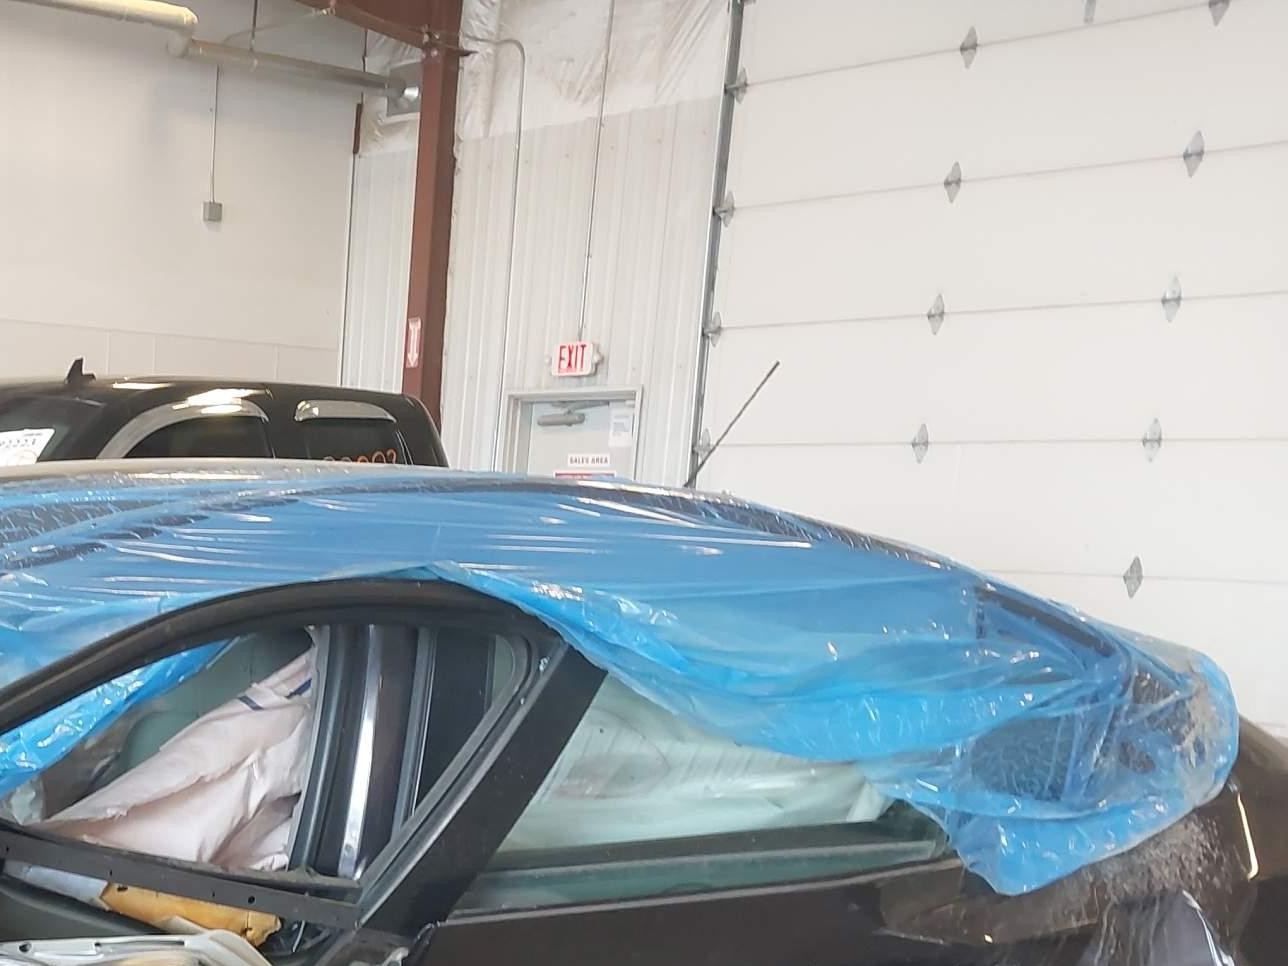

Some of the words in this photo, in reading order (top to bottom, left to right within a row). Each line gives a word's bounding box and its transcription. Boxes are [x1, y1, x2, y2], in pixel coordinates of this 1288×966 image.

[557, 344, 587, 373] EXIT
[569, 455, 589, 465] SALES
[590, 455, 608, 464] AREA
